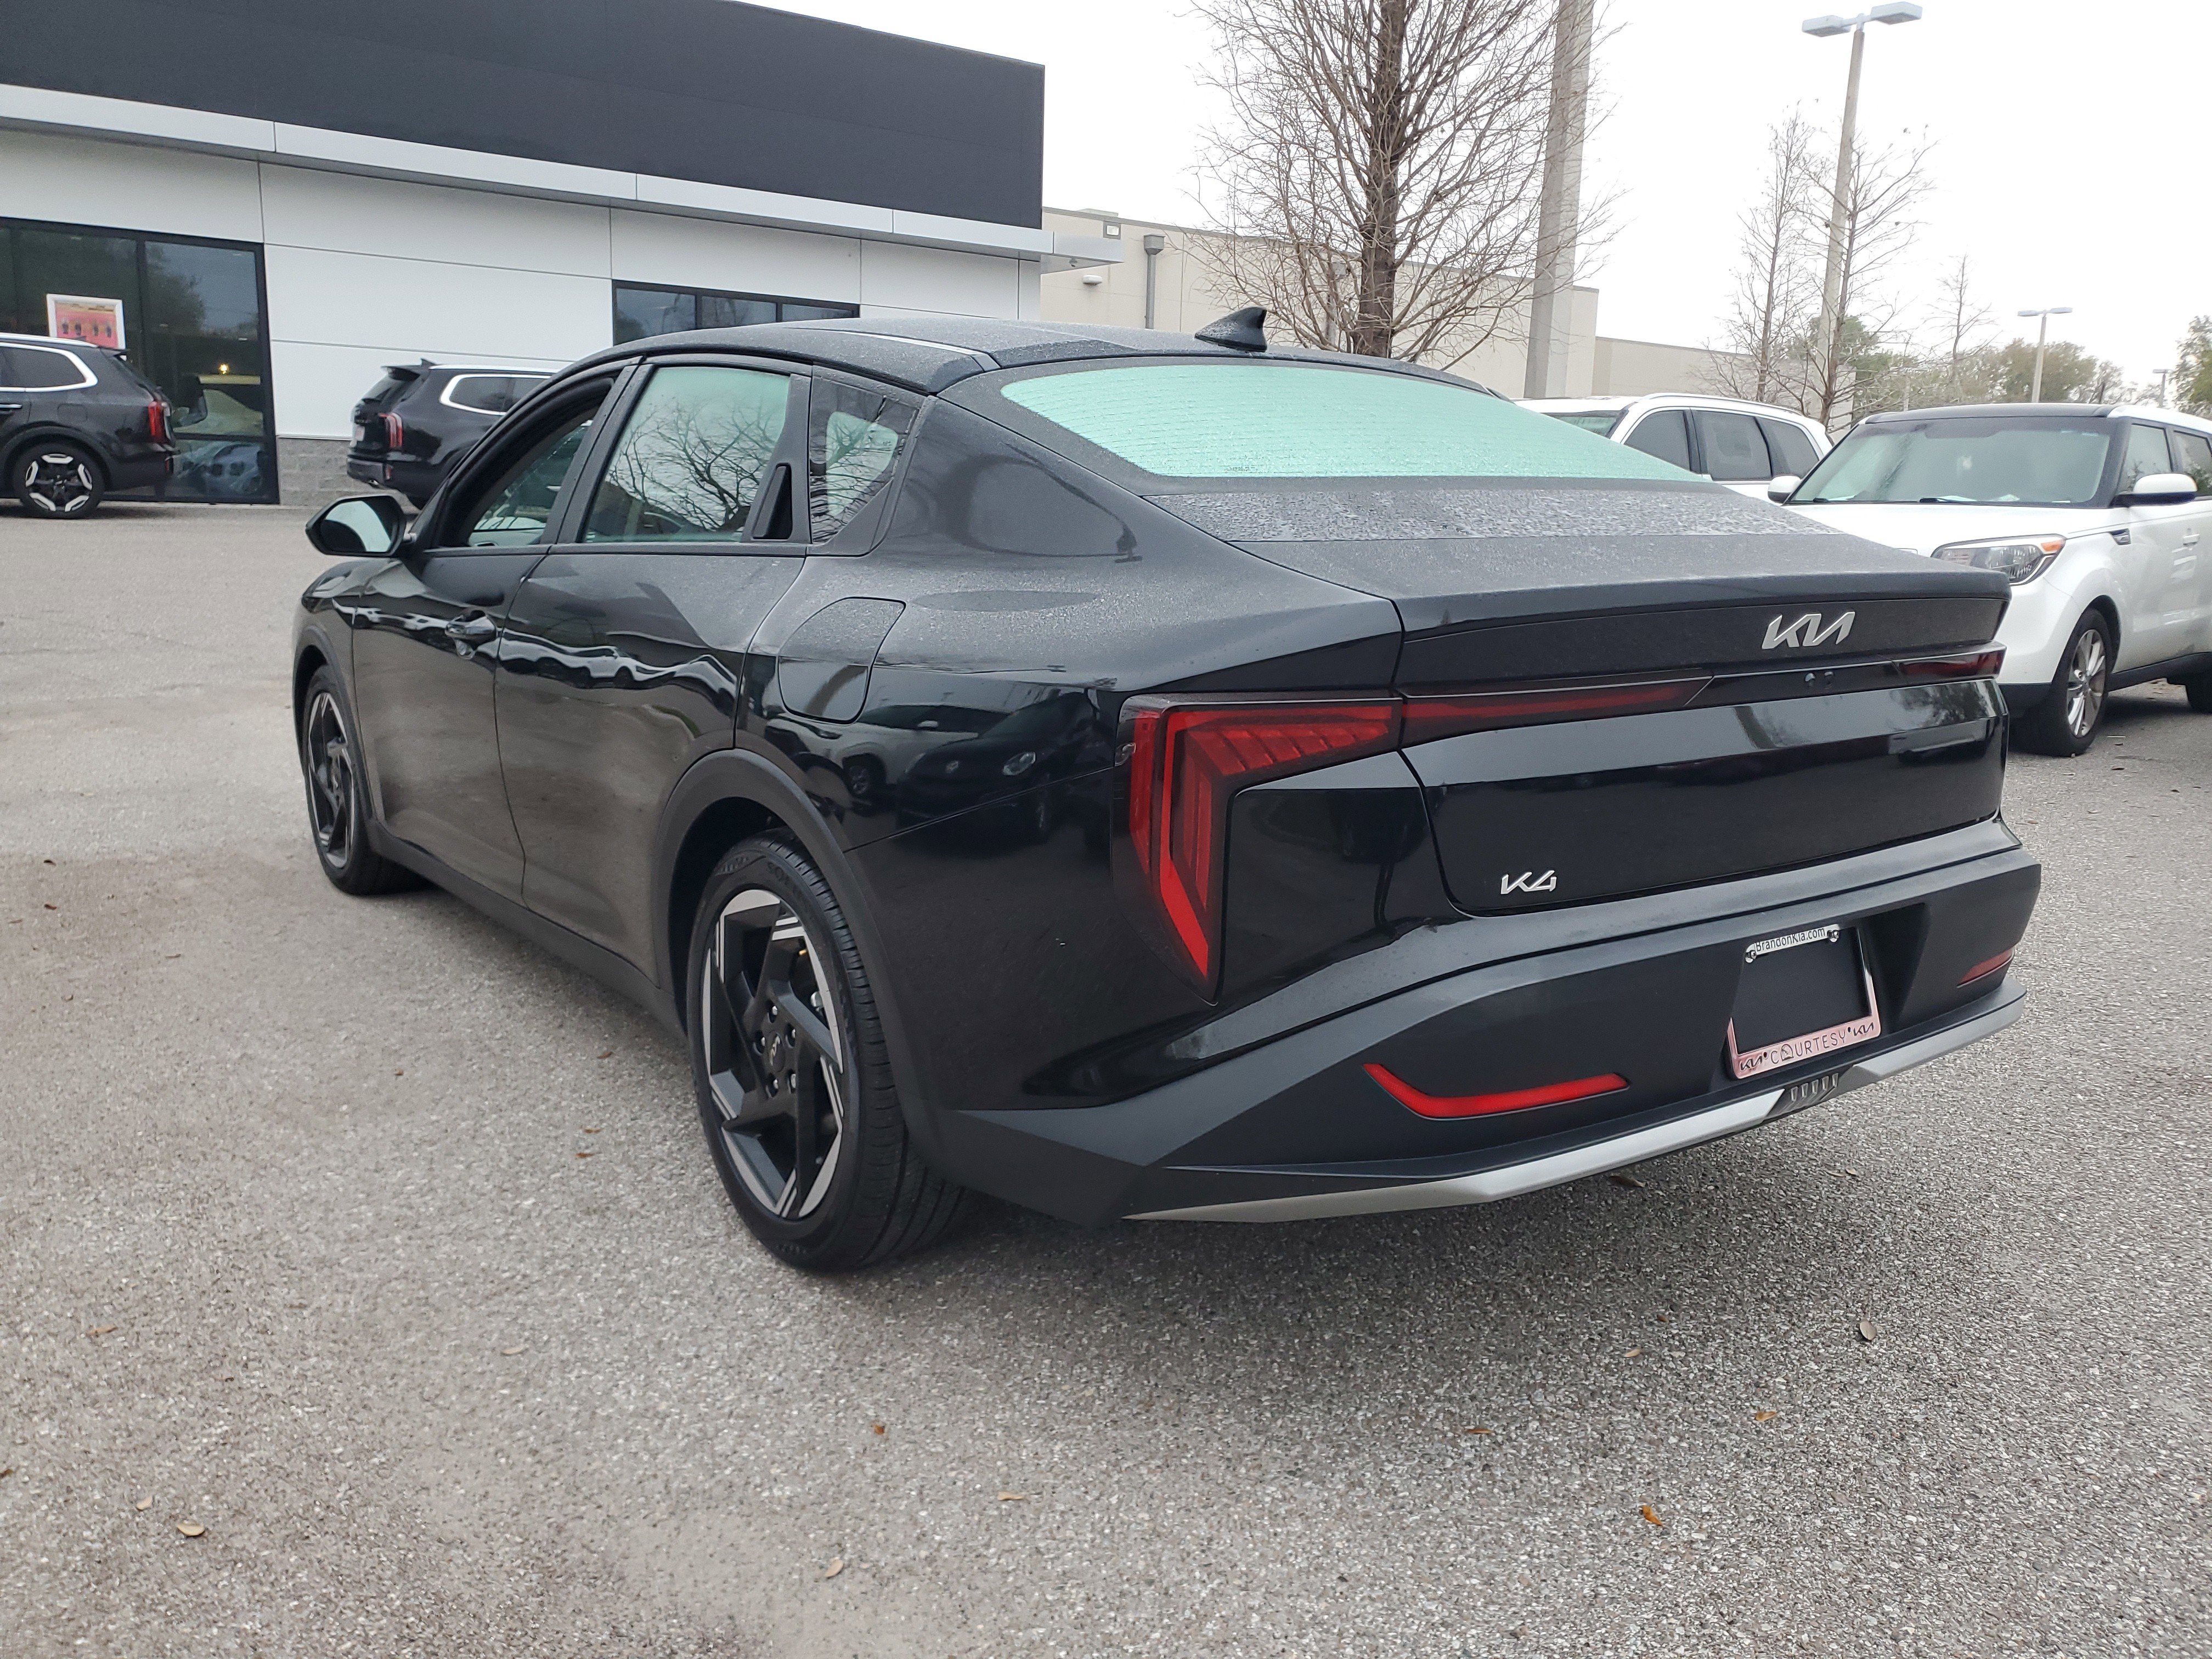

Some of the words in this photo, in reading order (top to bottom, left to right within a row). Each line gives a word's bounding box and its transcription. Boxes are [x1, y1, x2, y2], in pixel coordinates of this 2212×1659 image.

[1762, 611, 1856, 650] KIA
[1500, 870, 1557, 895] K4
[1755, 928, 1826, 952] BrandonKia.com
[1740, 1056, 1763, 1071] KIA
[1853, 1022, 1874, 1036] KIA
